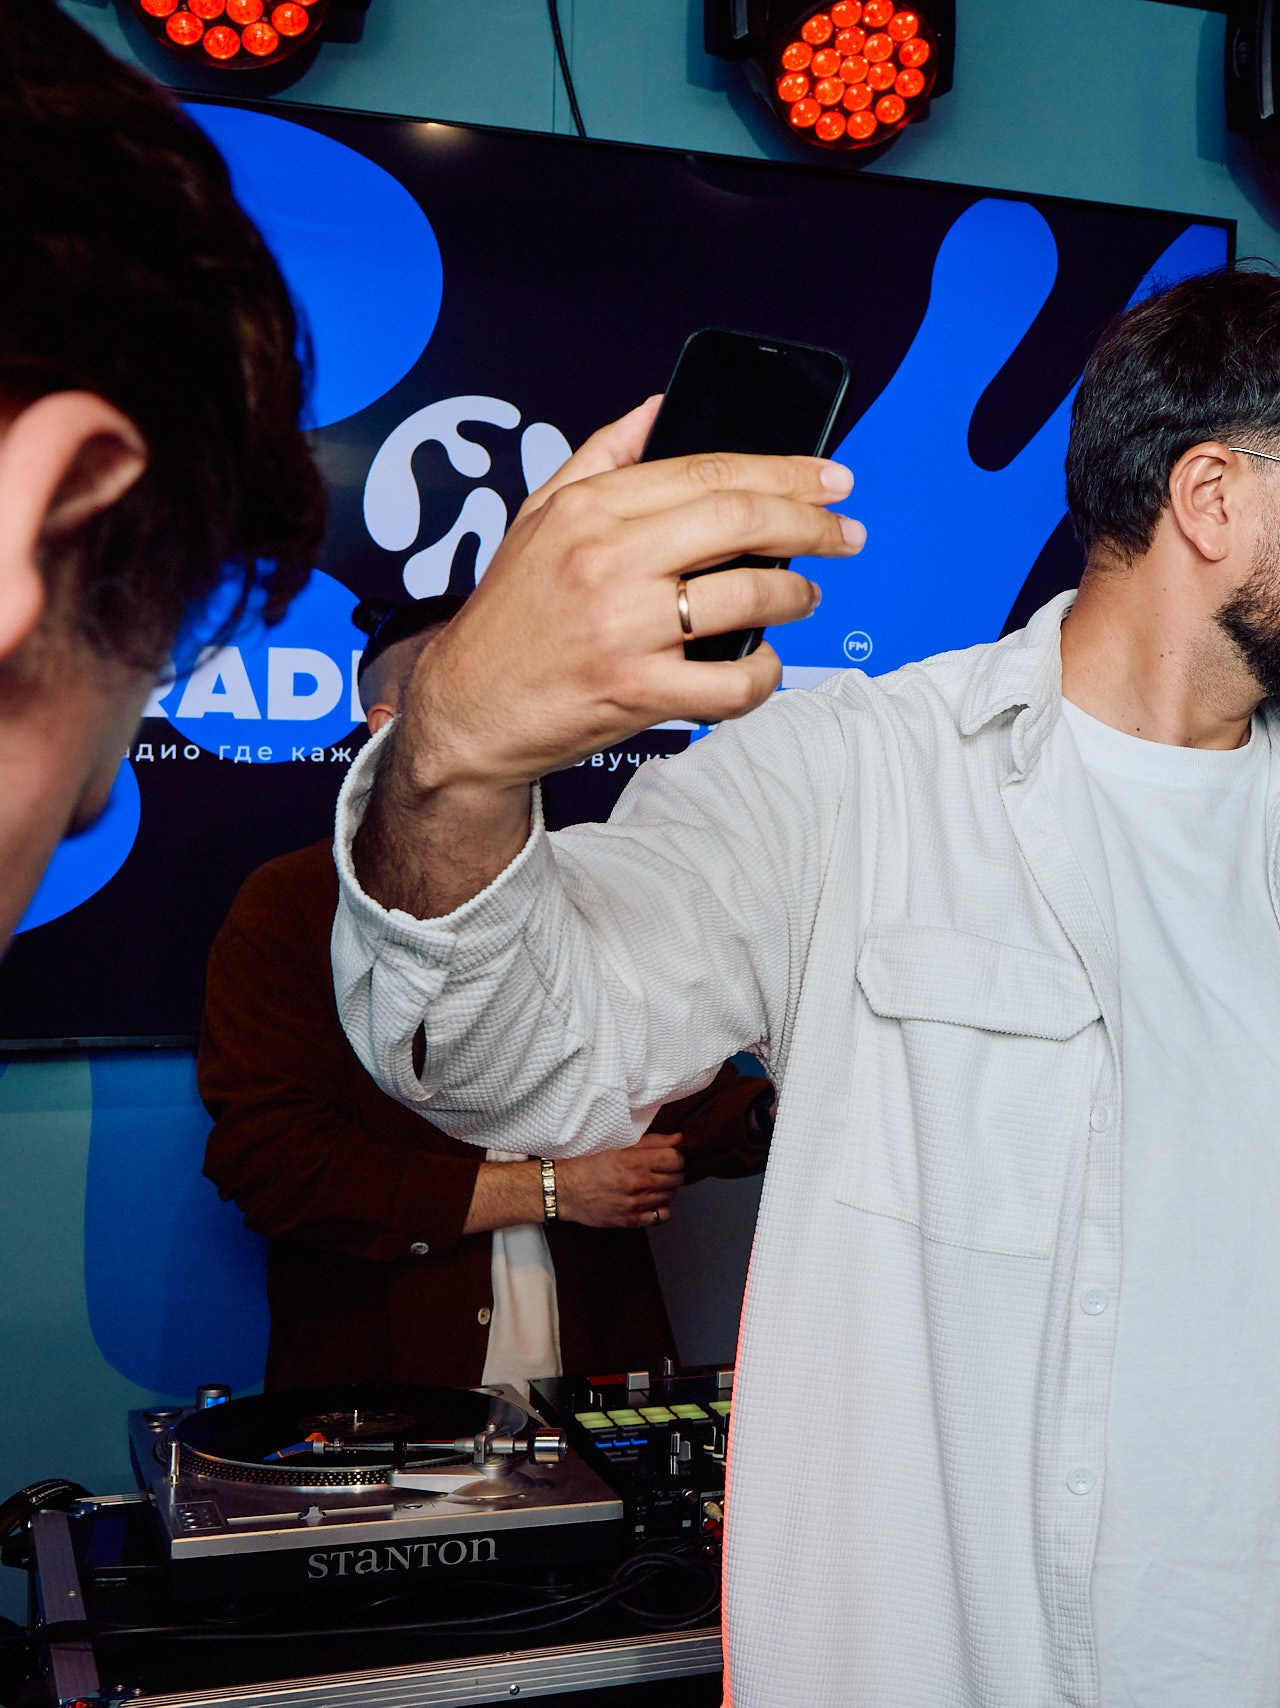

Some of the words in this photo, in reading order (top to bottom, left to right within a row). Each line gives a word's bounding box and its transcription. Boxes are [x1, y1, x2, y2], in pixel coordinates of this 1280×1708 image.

[848, 641, 868, 651] FM
[218, 745, 273, 764] где
[291, 746, 353, 763] каж
